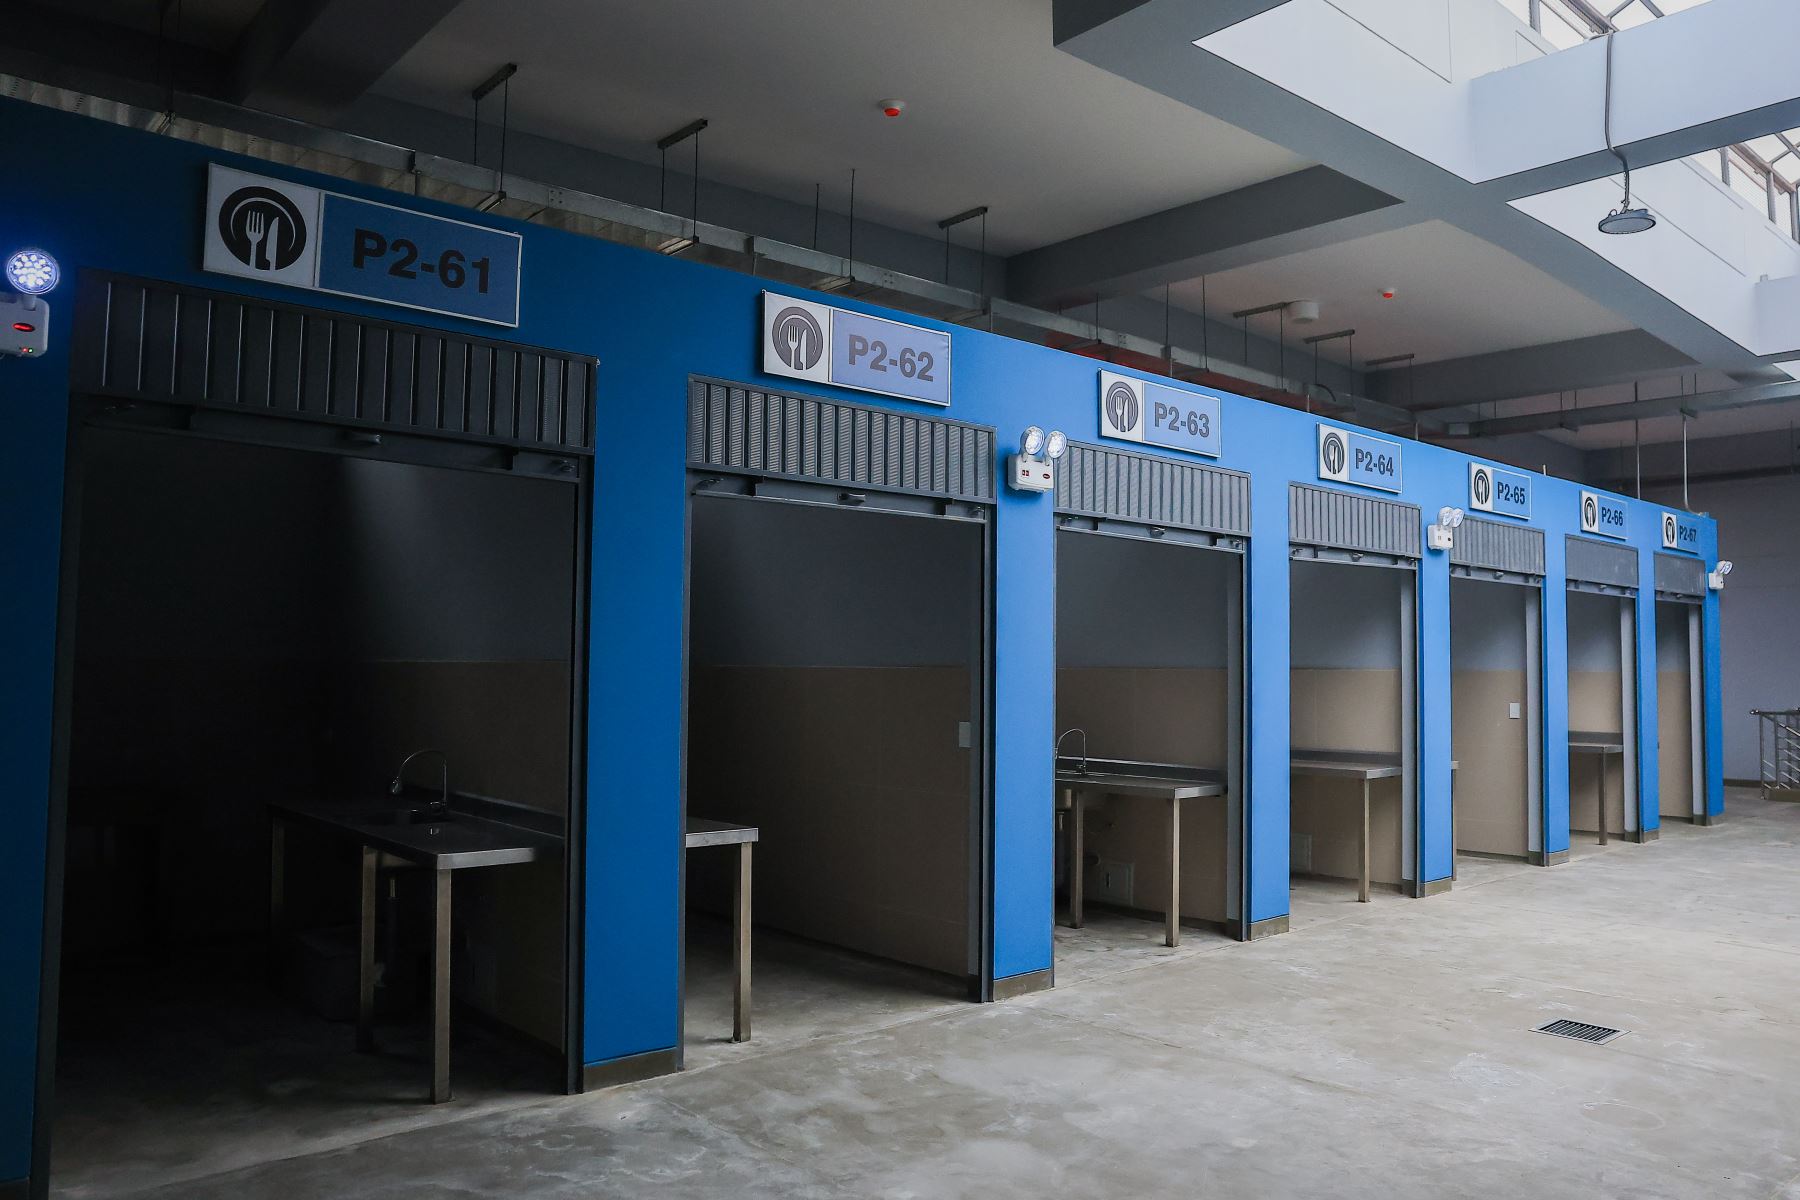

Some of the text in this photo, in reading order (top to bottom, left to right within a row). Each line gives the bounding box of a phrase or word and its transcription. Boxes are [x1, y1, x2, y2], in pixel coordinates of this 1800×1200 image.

[353, 228, 490, 294] P2-61
[849, 334, 934, 382] P2-62
[1154, 401, 1210, 438] P2-63
[1355, 447, 1394, 477] P2-64
[1497, 481, 1526, 505] P2-65
[1601, 506, 1624, 527] P2-66
[1679, 524, 1697, 542] P2-67
